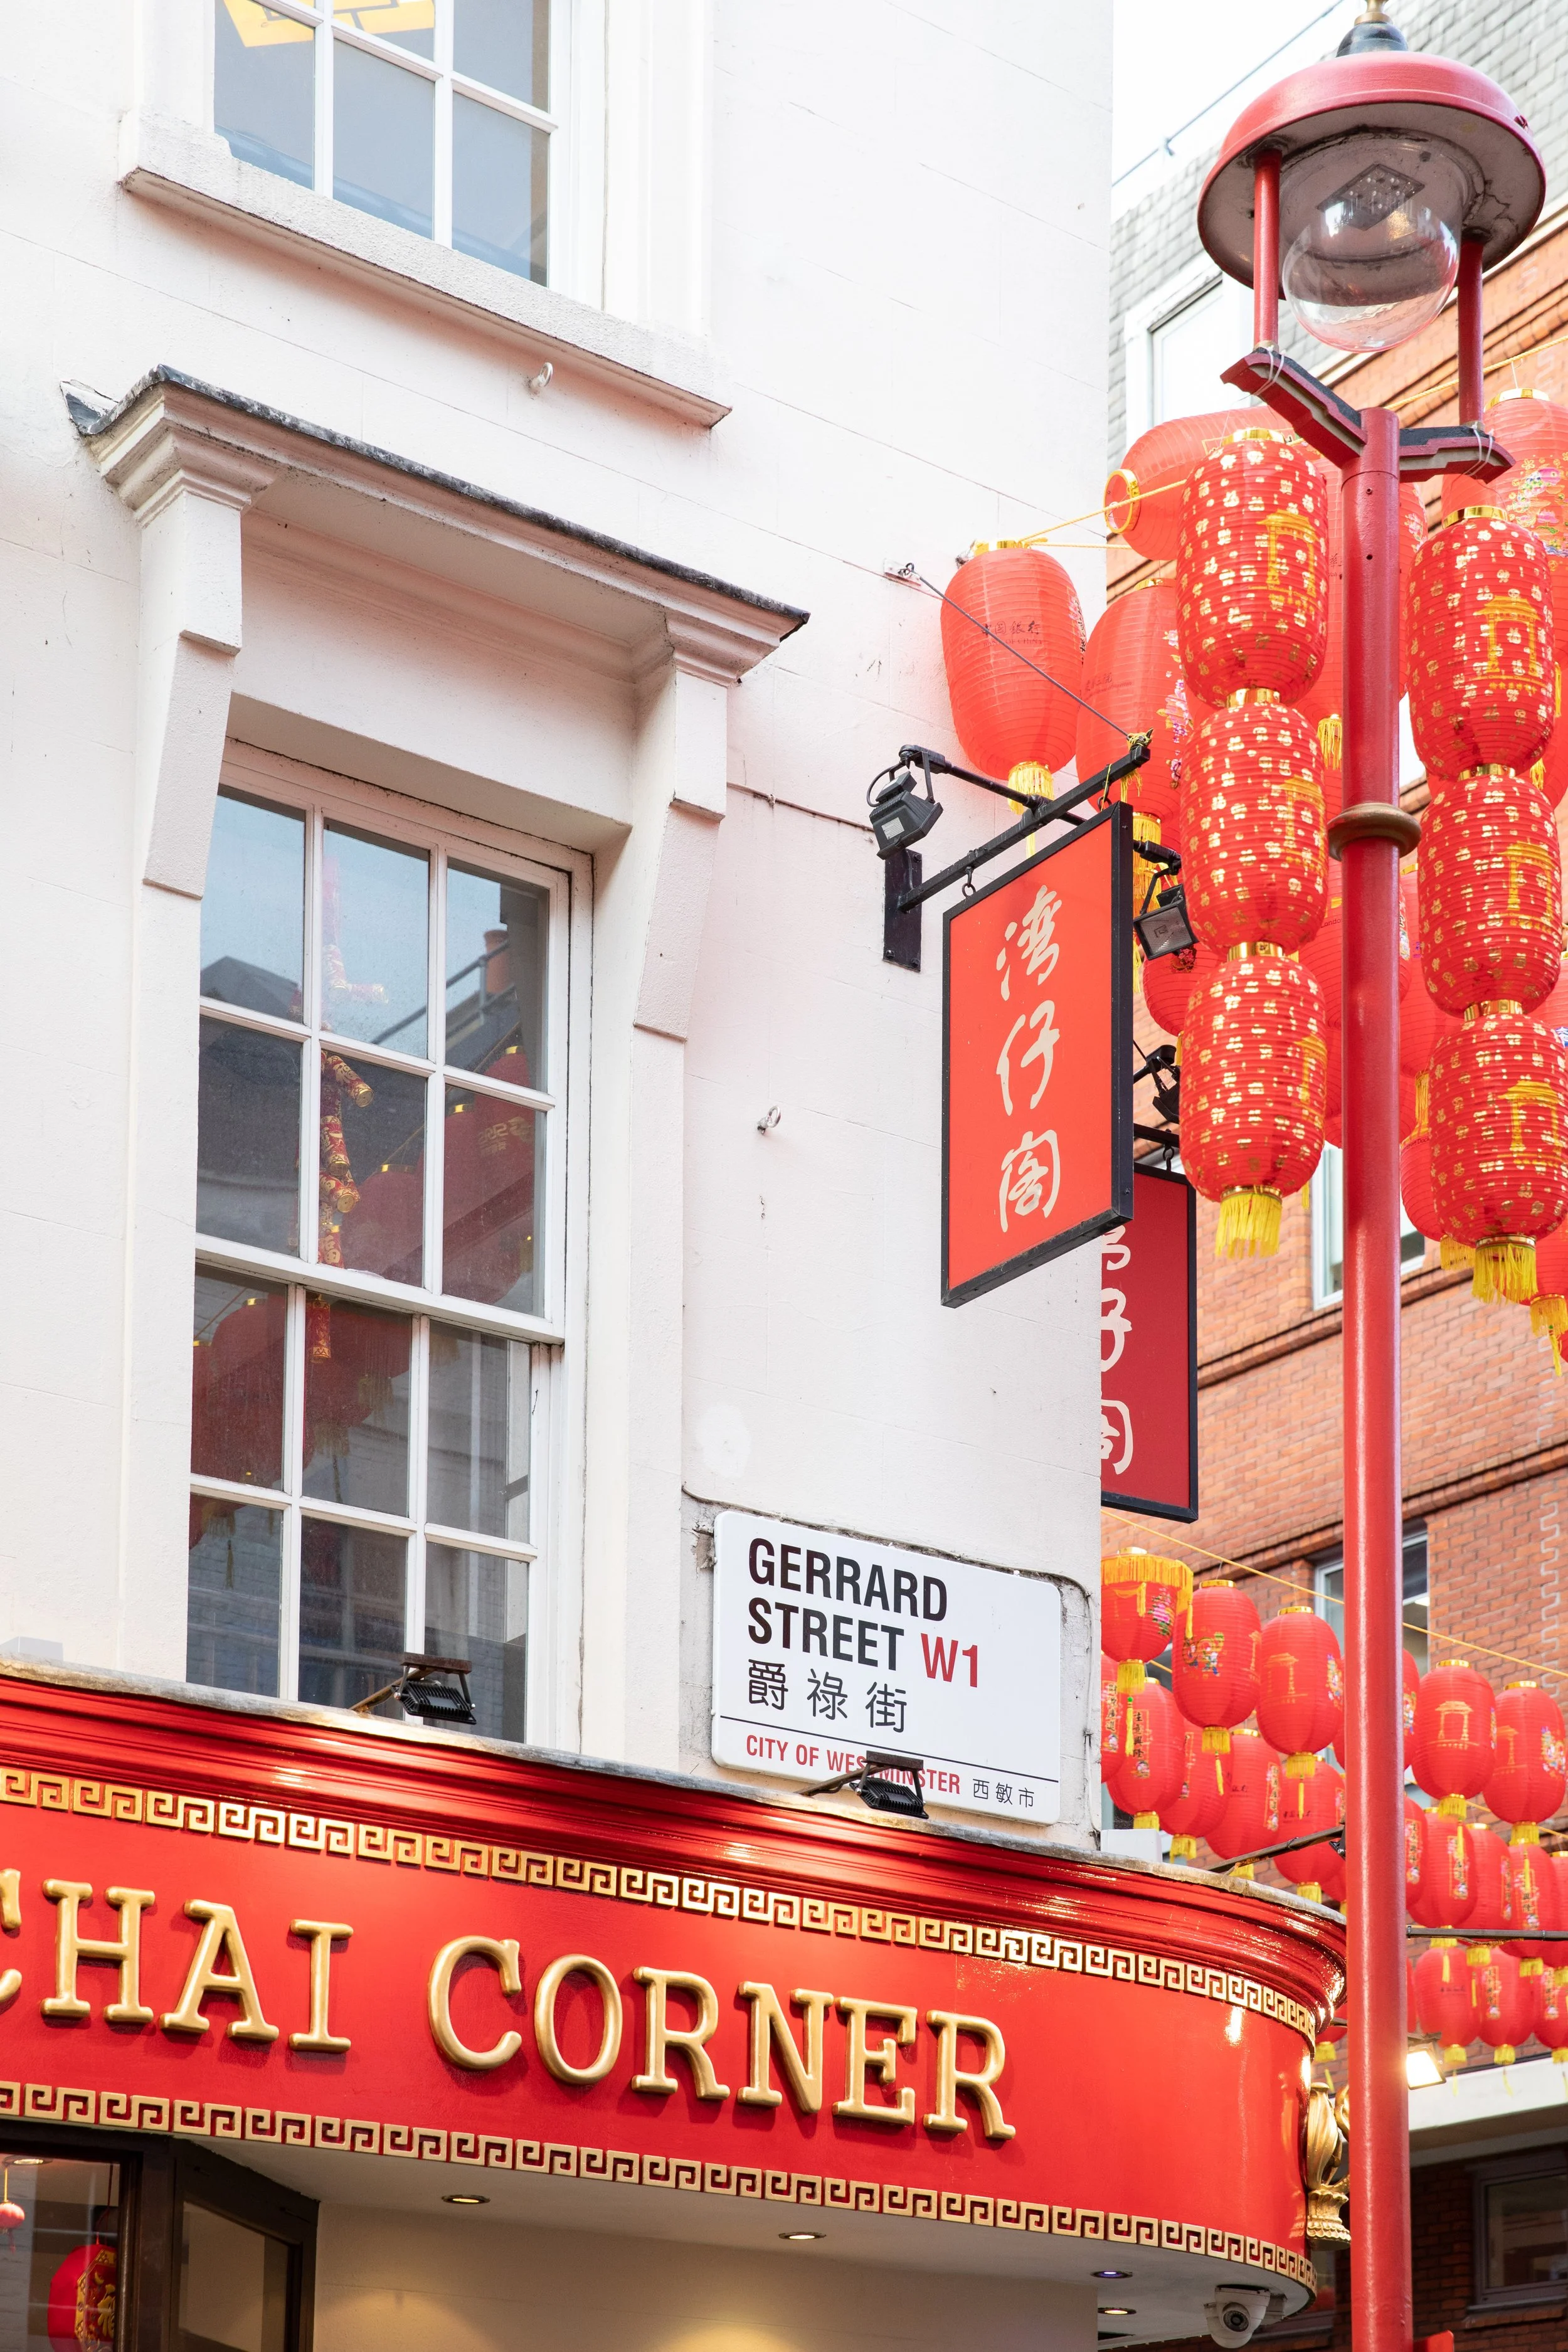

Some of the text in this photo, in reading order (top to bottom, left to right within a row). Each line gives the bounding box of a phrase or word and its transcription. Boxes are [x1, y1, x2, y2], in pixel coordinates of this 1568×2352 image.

[749, 1538, 947, 1622] GERRARD
[748, 1597, 978, 1687] STREET W1
[746, 1735, 960, 1794] CITY OF WESMINSTER
[972, 1778, 1035, 1808] 西敏市
[0, 1868, 354, 2054] HAI
[426, 1935, 1016, 2140] CORNER
